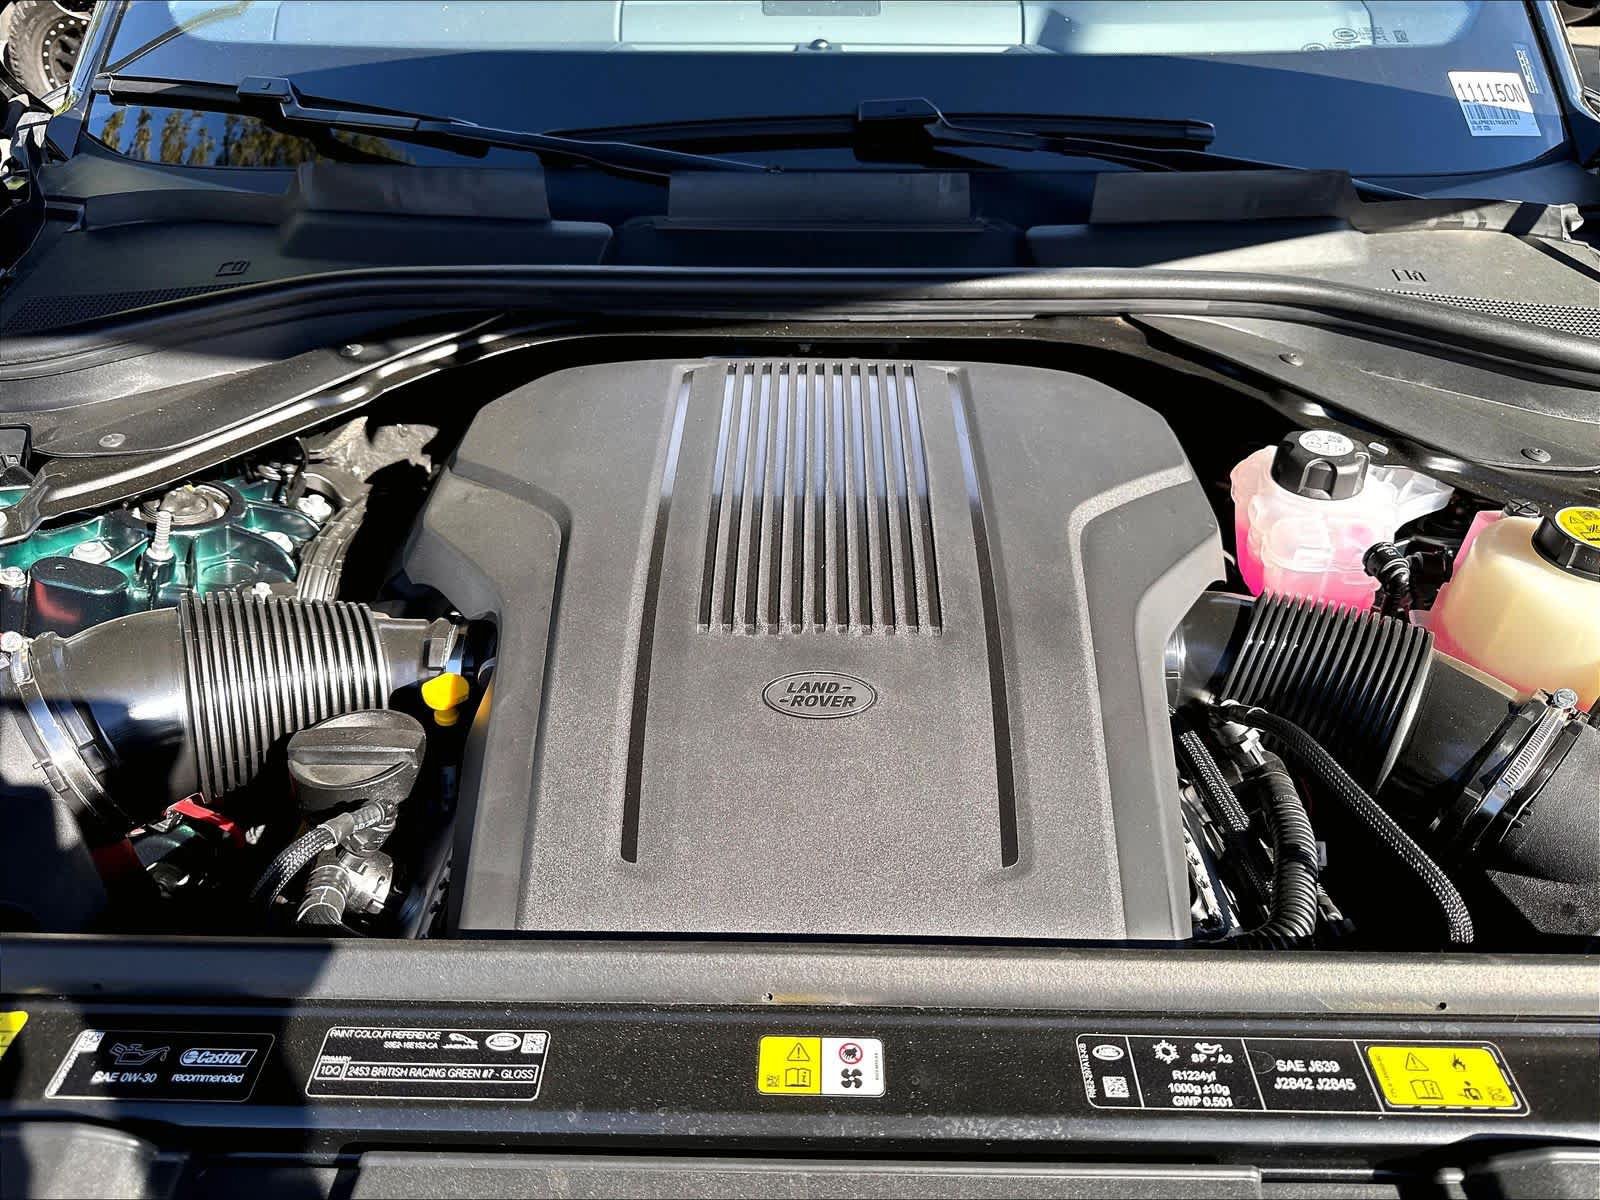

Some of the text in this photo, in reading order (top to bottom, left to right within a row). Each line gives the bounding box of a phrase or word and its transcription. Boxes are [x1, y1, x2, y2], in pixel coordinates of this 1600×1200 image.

[330, 1030, 441, 1040] PAINT COLOUR REFERENCE
[196, 1051, 247, 1065] Castrol
[1217, 1054, 1233, 1064] A2
[347, 1066, 371, 1077] 2453
[371, 1067, 409, 1077] BRITISH
[409, 1068, 447, 1078] RACING
[447, 1068, 481, 1078] GREEN
[500, 1069, 535, 1079] GLOSS
[1276, 1060, 1341, 1073] SAE J639
[91, 1071, 158, 1084] SAE 0W-30
[171, 1073, 244, 1084] recommended
[1274, 1077, 1357, 1091] J2842 J2845
[1168, 1083, 1201, 1096] 1000g
[1172, 1096, 1234, 1108] GWP 0.501
